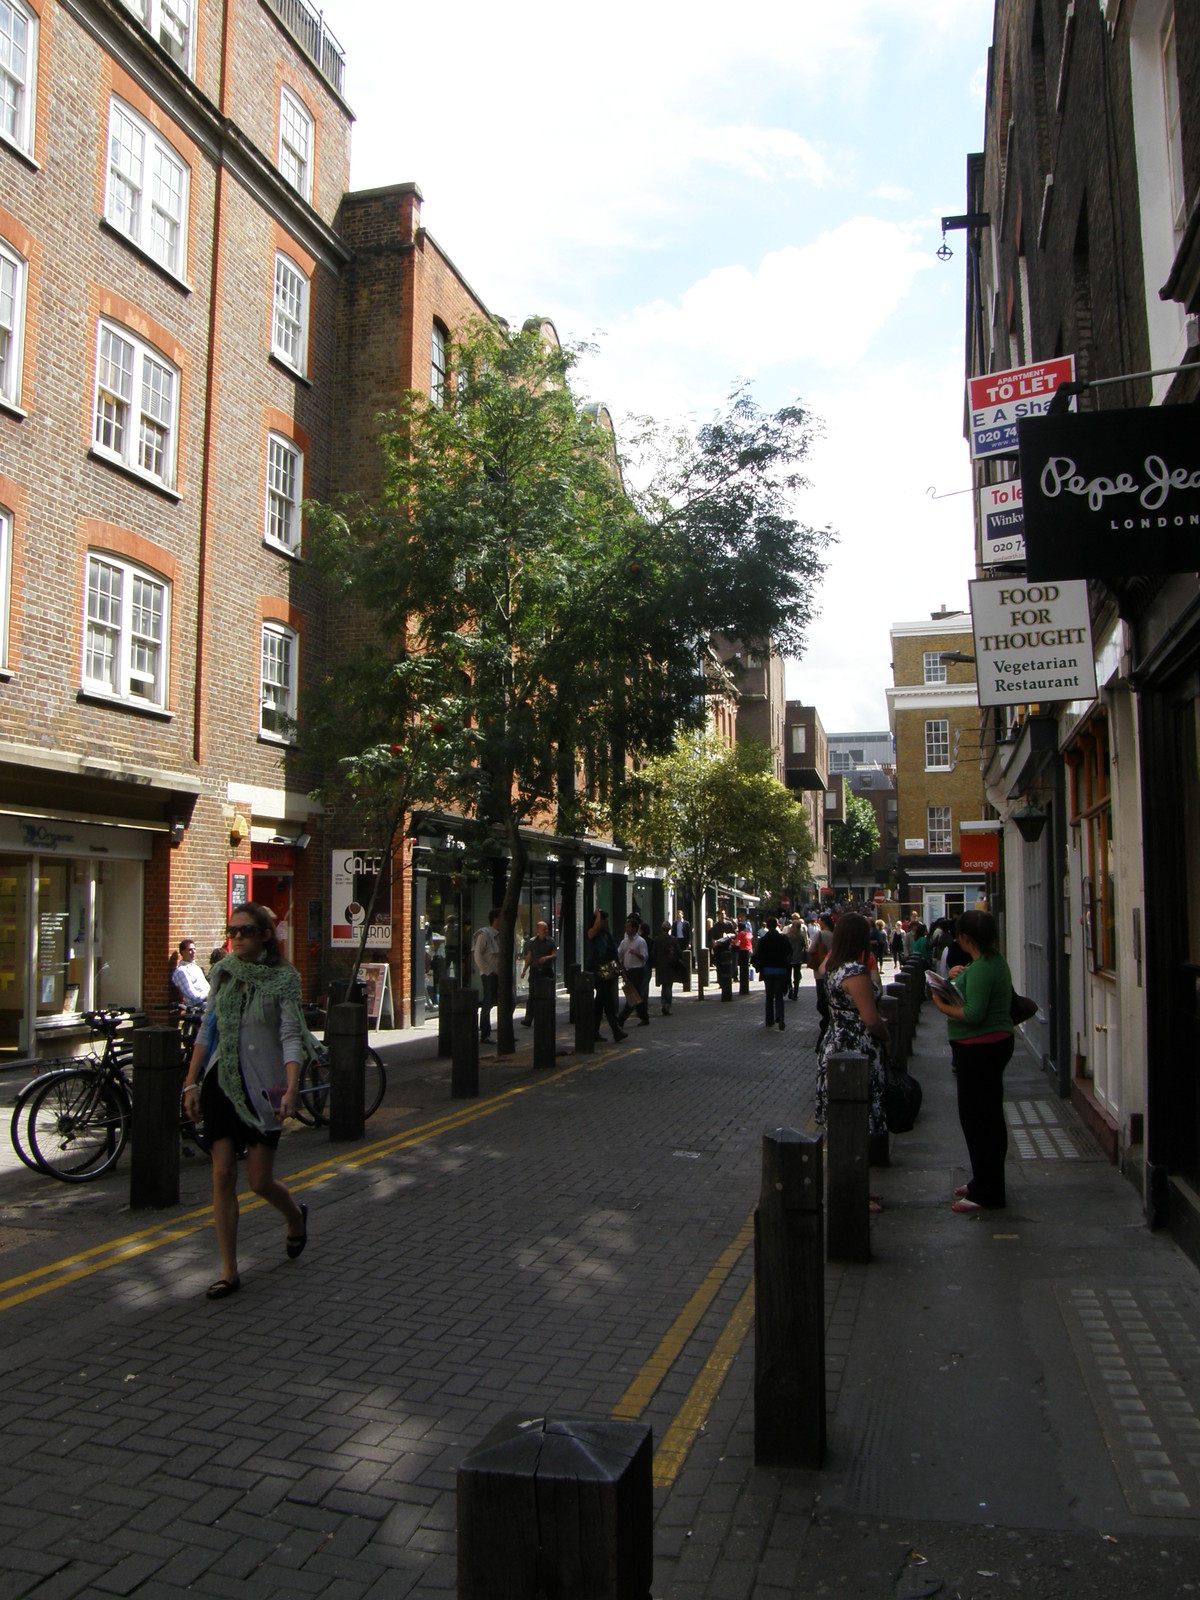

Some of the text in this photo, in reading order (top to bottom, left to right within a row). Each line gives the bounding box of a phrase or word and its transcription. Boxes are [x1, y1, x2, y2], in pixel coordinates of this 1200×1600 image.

[997, 368, 1045, 386] APARTMENT
[986, 372, 1057, 403] TO LET
[972, 413, 986, 428] E
[992, 408, 1008, 424] A
[977, 430, 1001, 444] 020
[1040, 456, 1140, 512] Pepe
[991, 489, 1009, 505] To
[1110, 514, 1200, 530] LONDON
[993, 542, 1013, 553] 020
[998, 585, 1060, 606] FOOD
[1010, 608, 1053, 627] FOR
[979, 627, 1087, 651] THOUGHT
[993, 657, 1078, 675] Vegetarian
[994, 675, 1080, 693] Restaurant
[963, 860, 994, 869] orange
[352, 926, 391, 939] ETRNO
